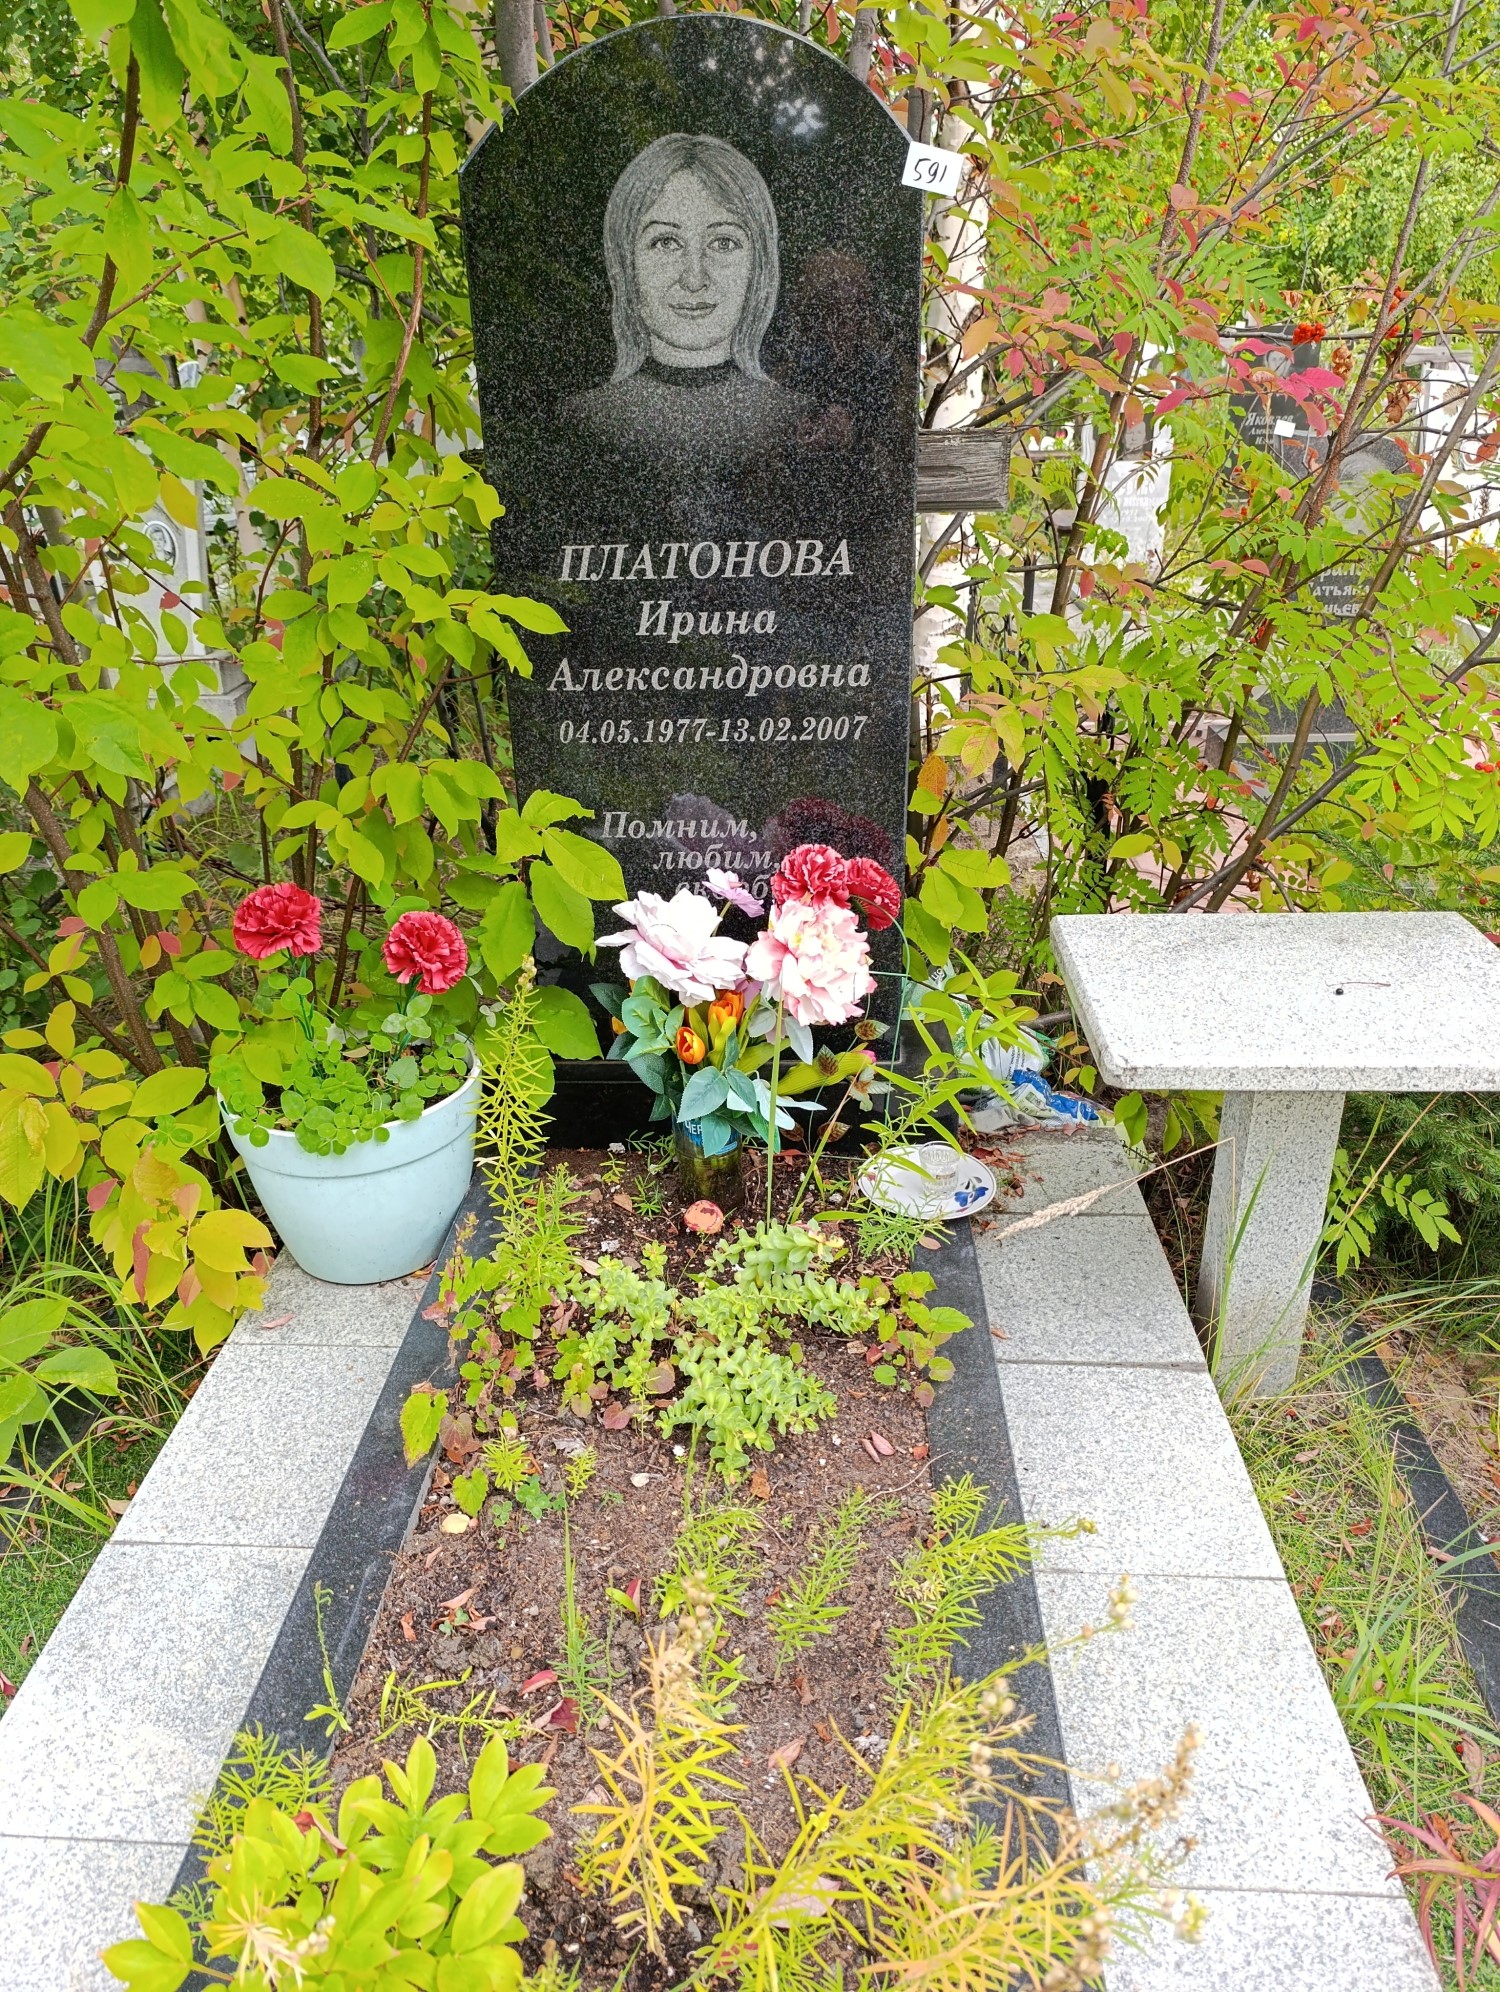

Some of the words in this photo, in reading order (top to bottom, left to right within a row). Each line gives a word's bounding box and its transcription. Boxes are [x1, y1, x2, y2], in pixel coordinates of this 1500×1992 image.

[913, 158, 947, 183] 591
[558, 539, 853, 581] ПЛАТОНОВА
[635, 600, 778, 643] Ирина
[547, 654, 871, 697] Александровна
[559, 715, 869, 744] 04.05.1977-13.02.2007
[600, 811, 758, 843] Помним,
